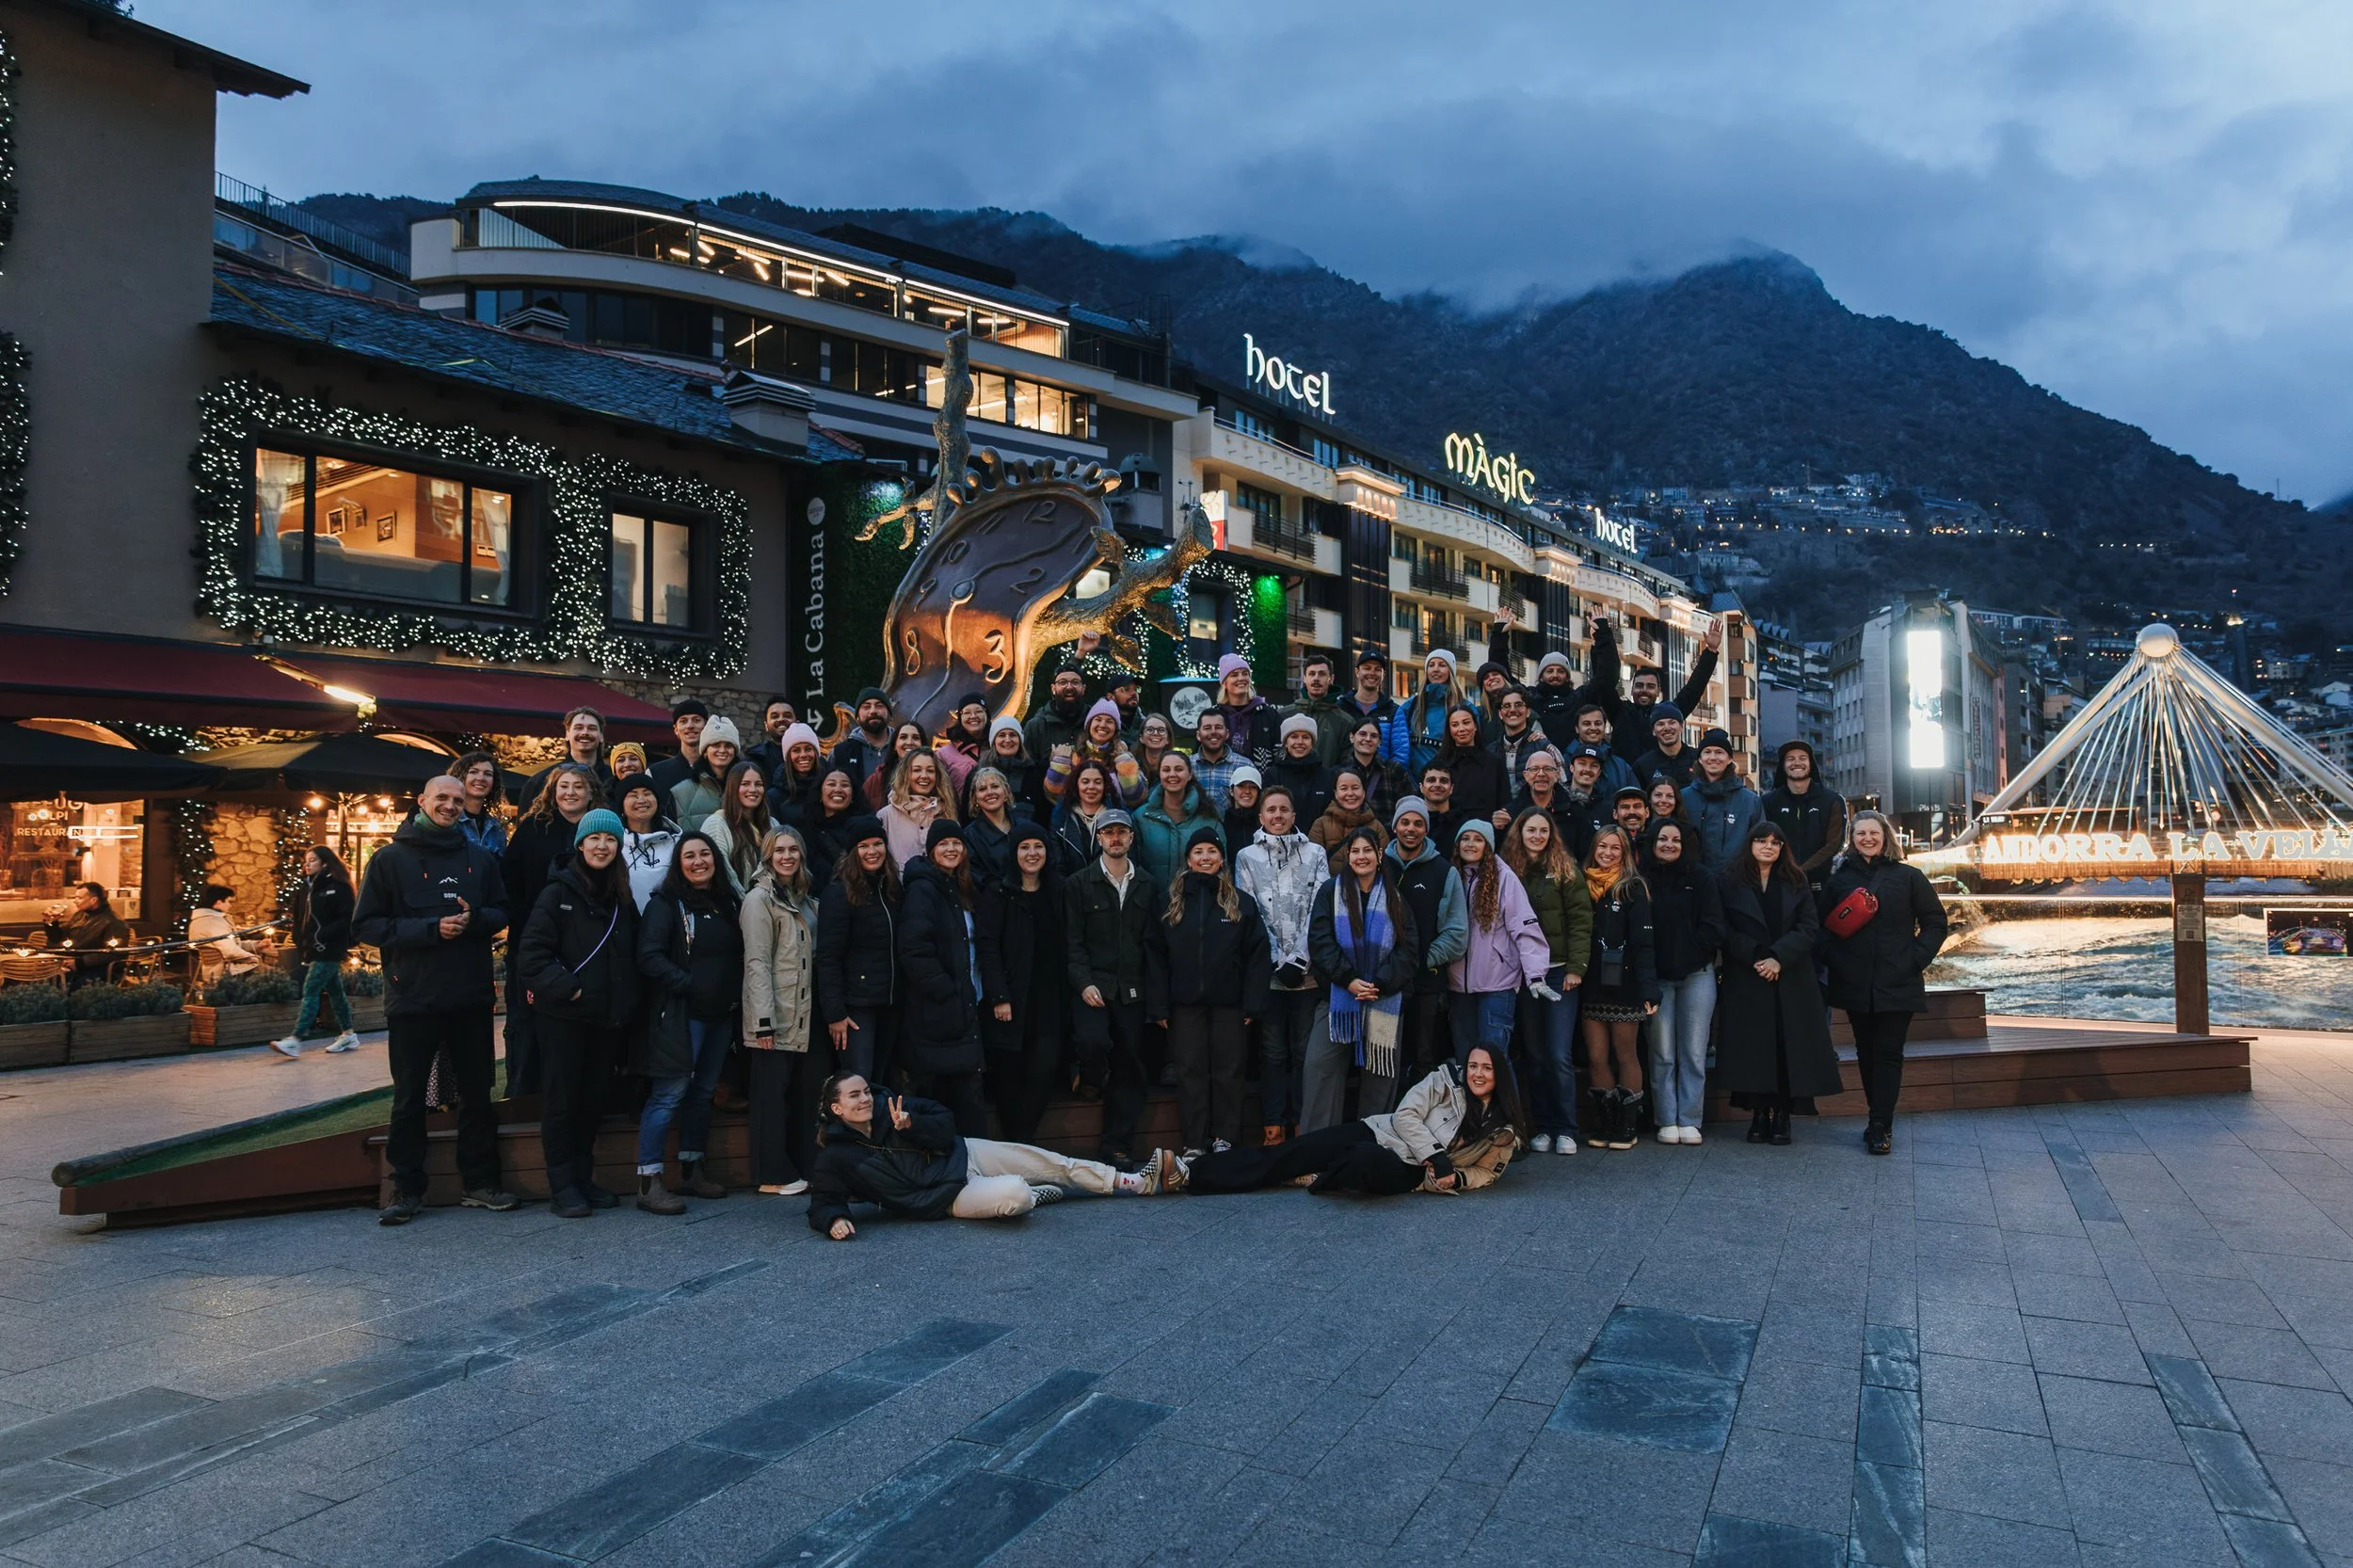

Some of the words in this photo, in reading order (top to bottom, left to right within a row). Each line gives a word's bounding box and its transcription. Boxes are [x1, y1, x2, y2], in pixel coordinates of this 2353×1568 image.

[1243, 332, 1336, 415] hotel
[1022, 500, 1056, 523] 12
[1594, 507, 1638, 553] hotel
[939, 539, 968, 564] 10
[805, 530, 824, 653] Cabana
[913, 577, 937, 613] 9
[1009, 567, 1046, 595] 2
[905, 629, 921, 676] 8
[984, 631, 1007, 684] 3
[806, 658, 824, 699] La
[1983, 833, 2157, 863] ANDORRA
[2168, 831, 2232, 860] LA
